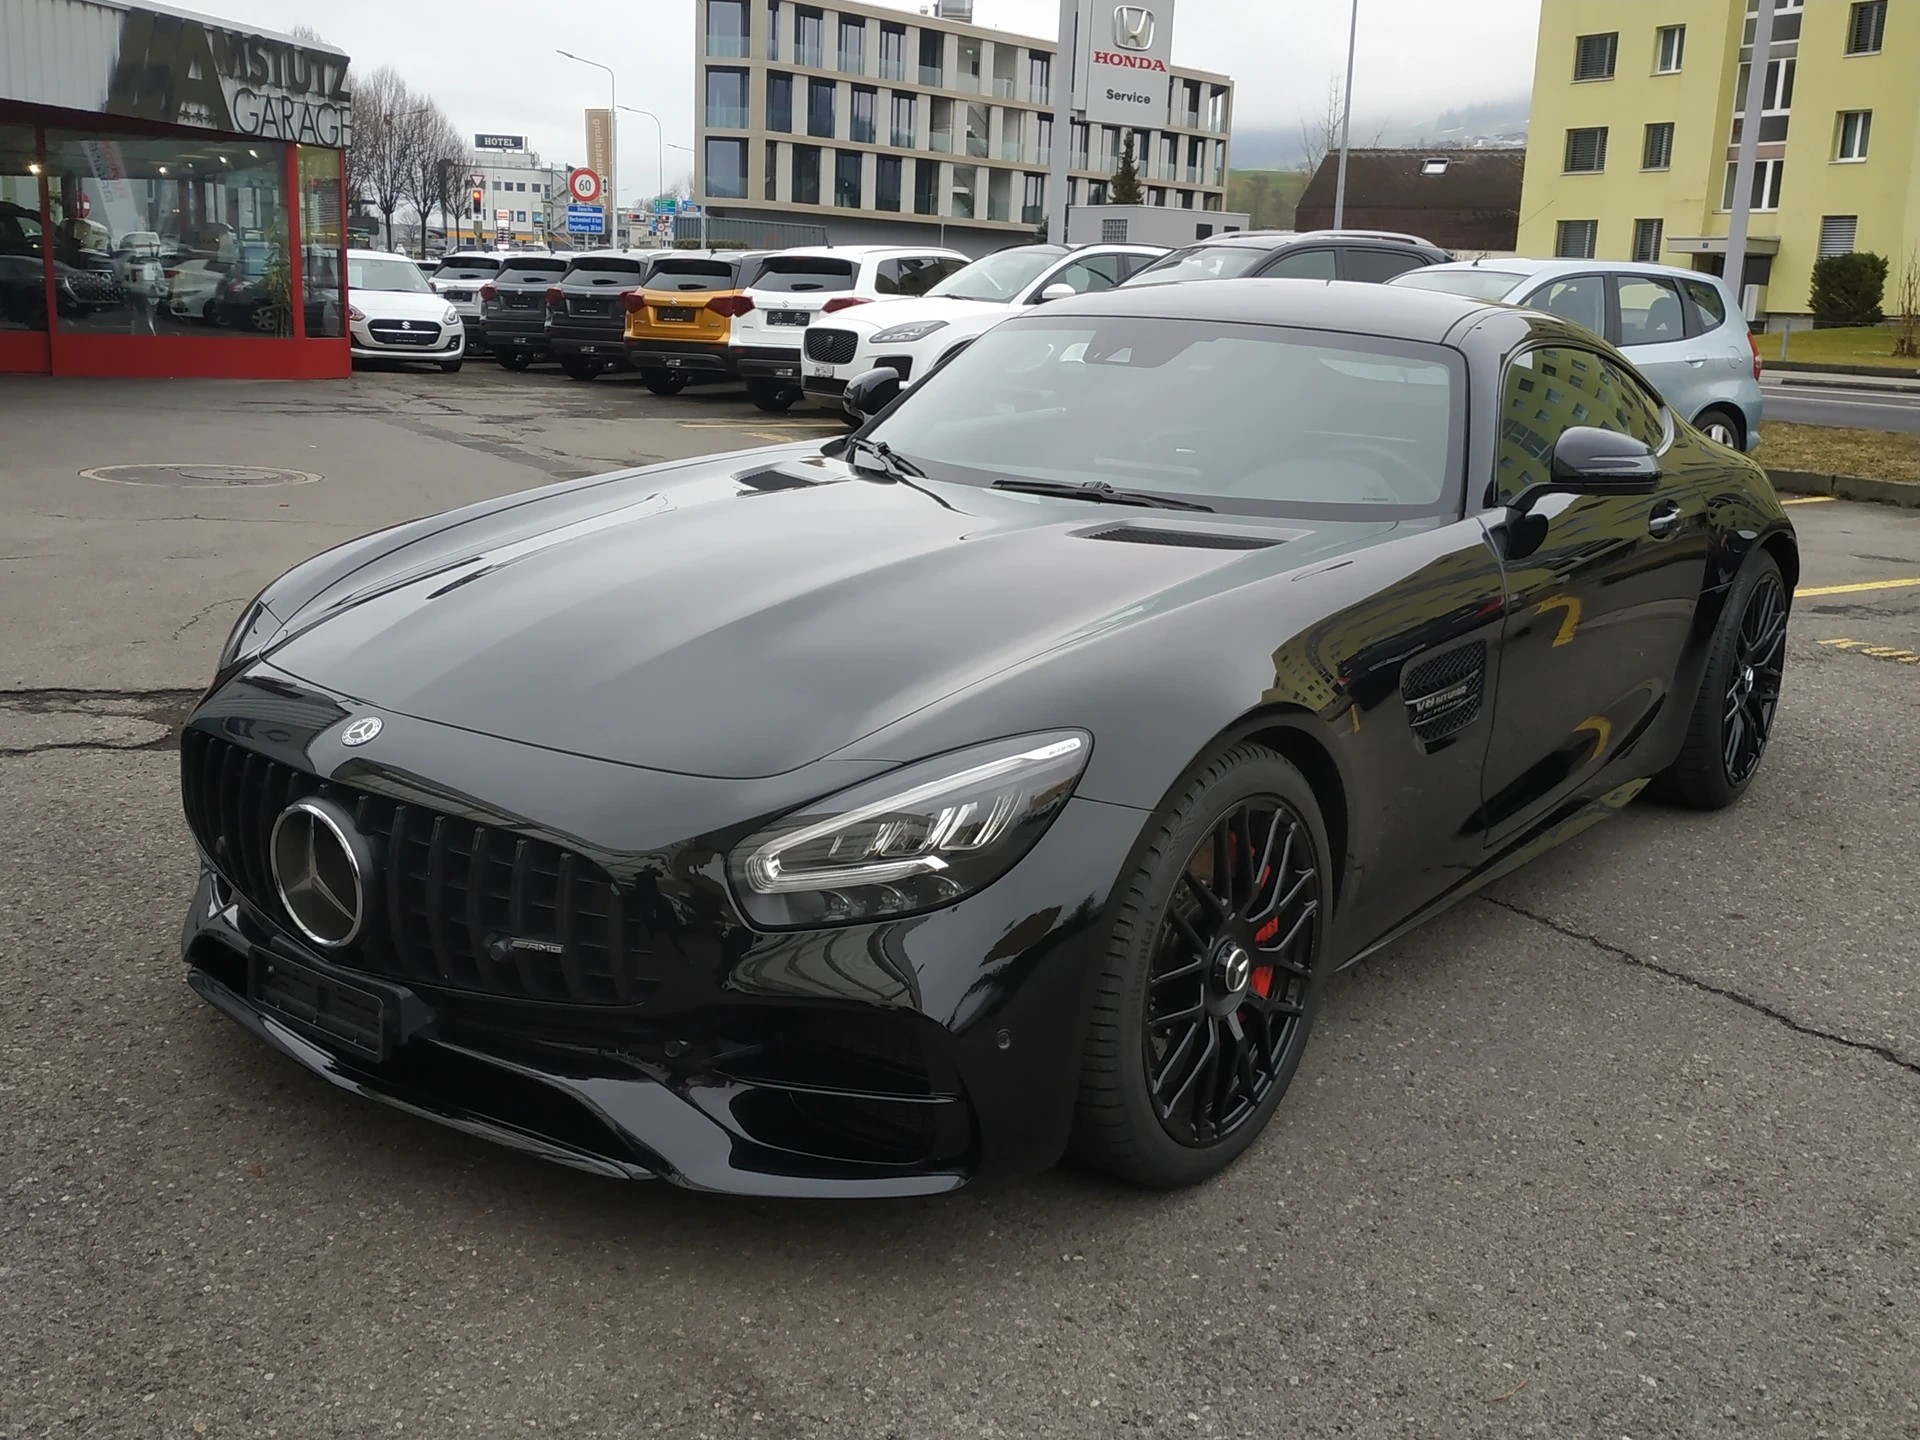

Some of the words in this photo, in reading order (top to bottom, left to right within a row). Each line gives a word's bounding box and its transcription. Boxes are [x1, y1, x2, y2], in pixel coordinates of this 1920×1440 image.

[1093, 51, 1167, 73] HONDA
[1106, 88, 1151, 104] Service
[233, 87, 352, 149] GARAGE
[484, 136, 515, 147] HOTEL
[579, 179, 592, 191] 60
[526, 942, 562, 954] AMG
